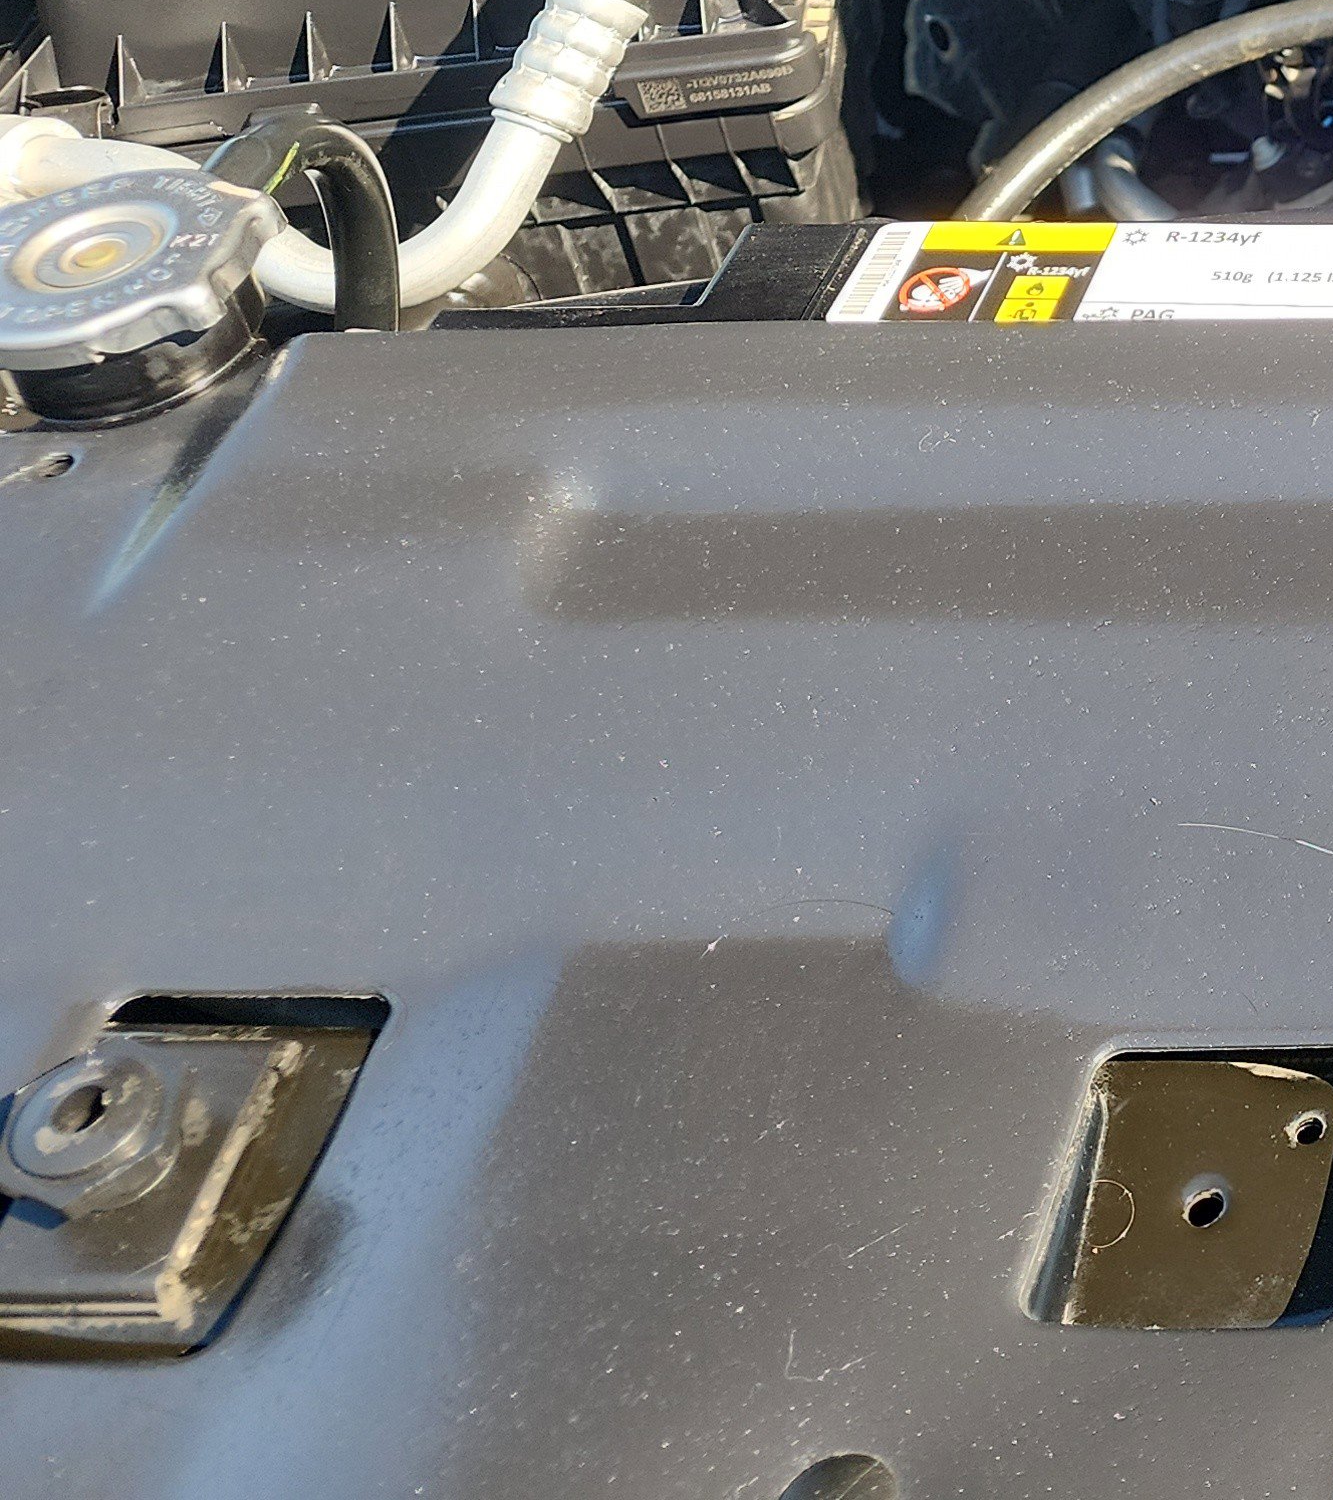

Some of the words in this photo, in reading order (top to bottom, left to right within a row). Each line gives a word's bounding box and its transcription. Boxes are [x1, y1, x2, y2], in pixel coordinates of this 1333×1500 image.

[1165, 230, 1263, 247] R-1234yf
[1026, 265, 1091, 278] R-1234yf
[1210, 270, 1254, 284] 510g
[1266, 270, 1323, 284] (1.125
[1130, 309, 1175, 320] PAG
